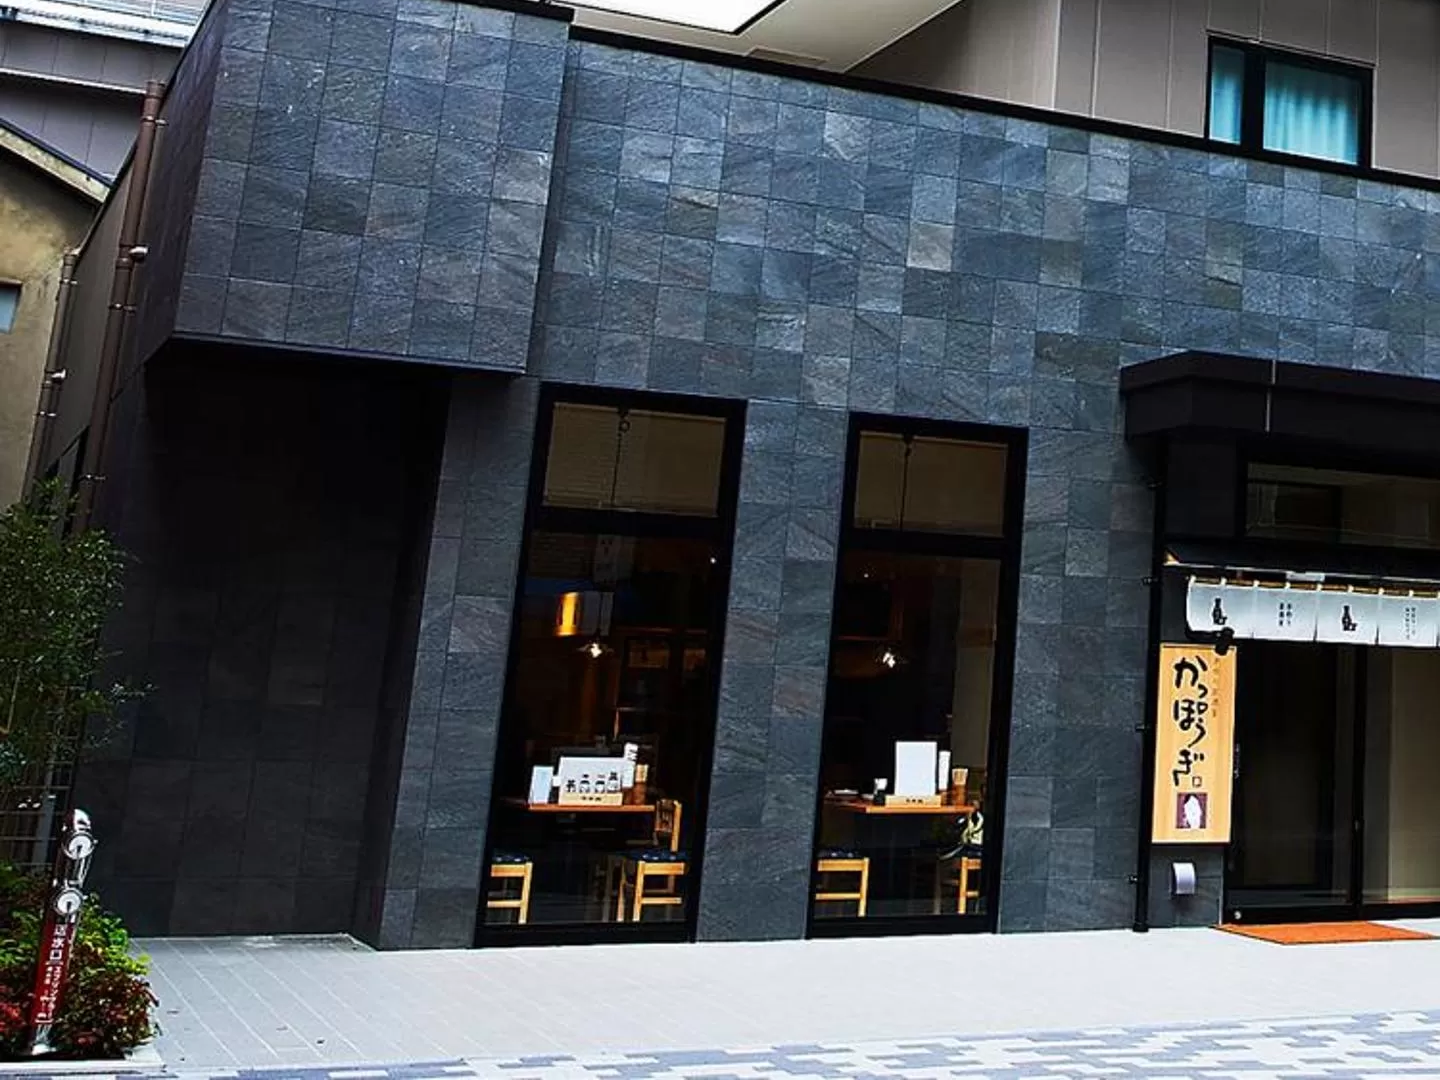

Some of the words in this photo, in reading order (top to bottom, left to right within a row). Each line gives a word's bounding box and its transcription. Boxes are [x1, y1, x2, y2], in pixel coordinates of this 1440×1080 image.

[1173, 655, 1208, 787] かっぽうぎ
